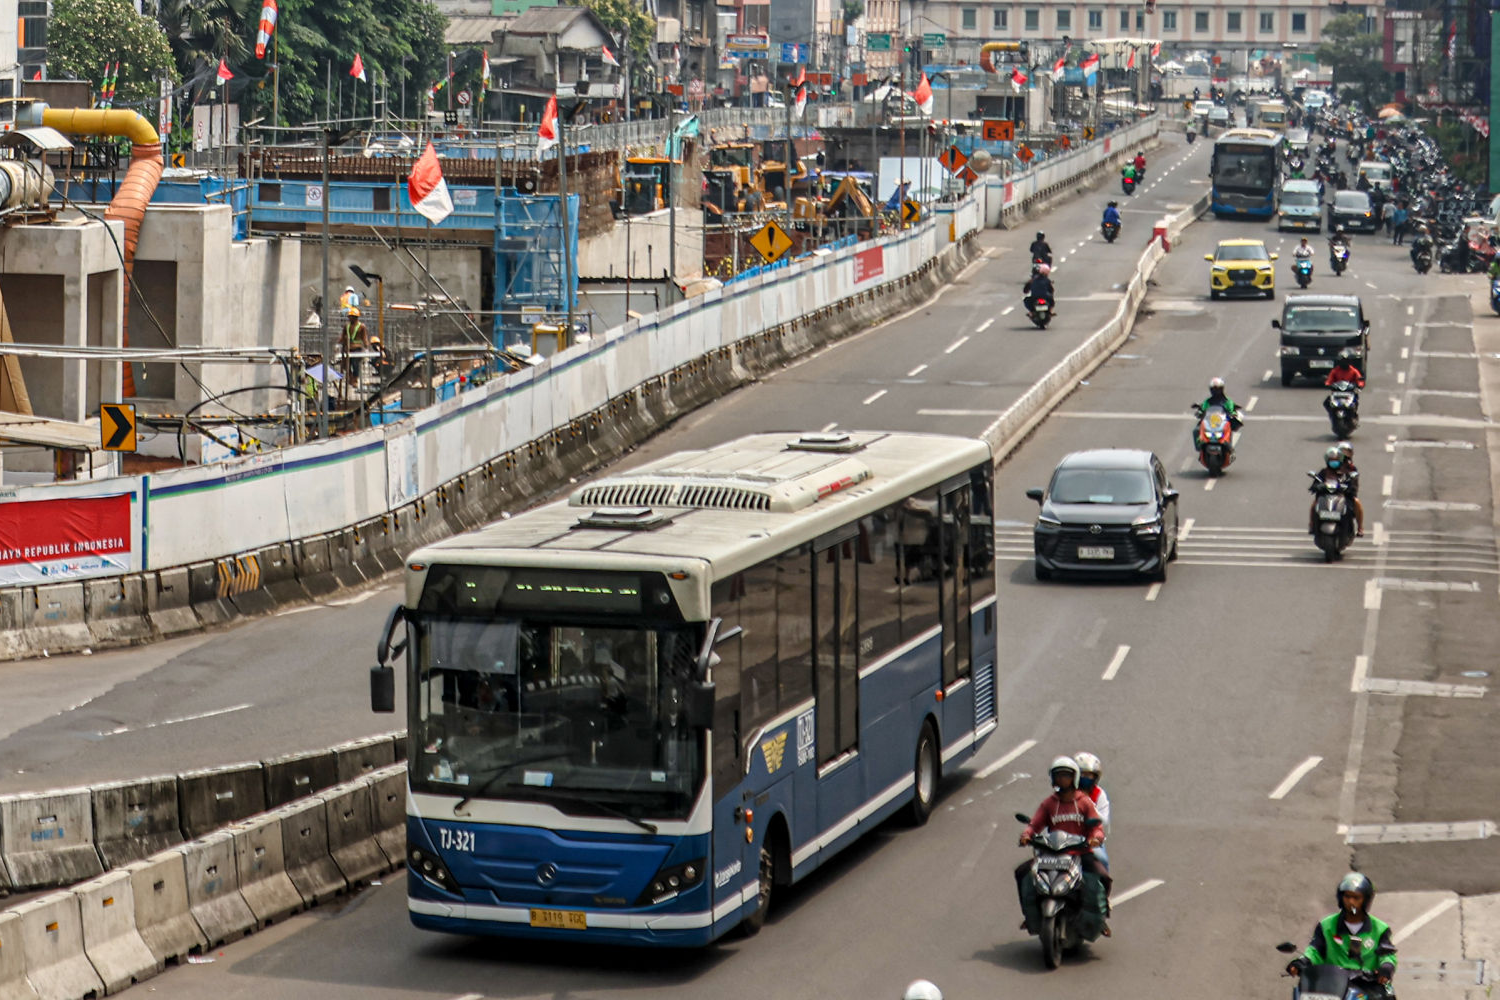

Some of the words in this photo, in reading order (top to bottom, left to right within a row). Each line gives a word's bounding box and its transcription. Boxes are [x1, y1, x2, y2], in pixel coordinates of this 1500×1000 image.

[987, 127, 1009, 139] E-1
[24, 543, 70, 558] REPUBLIK
[73, 537, 124, 552] INDONESIA
[440, 828, 475, 852] TJ-321
